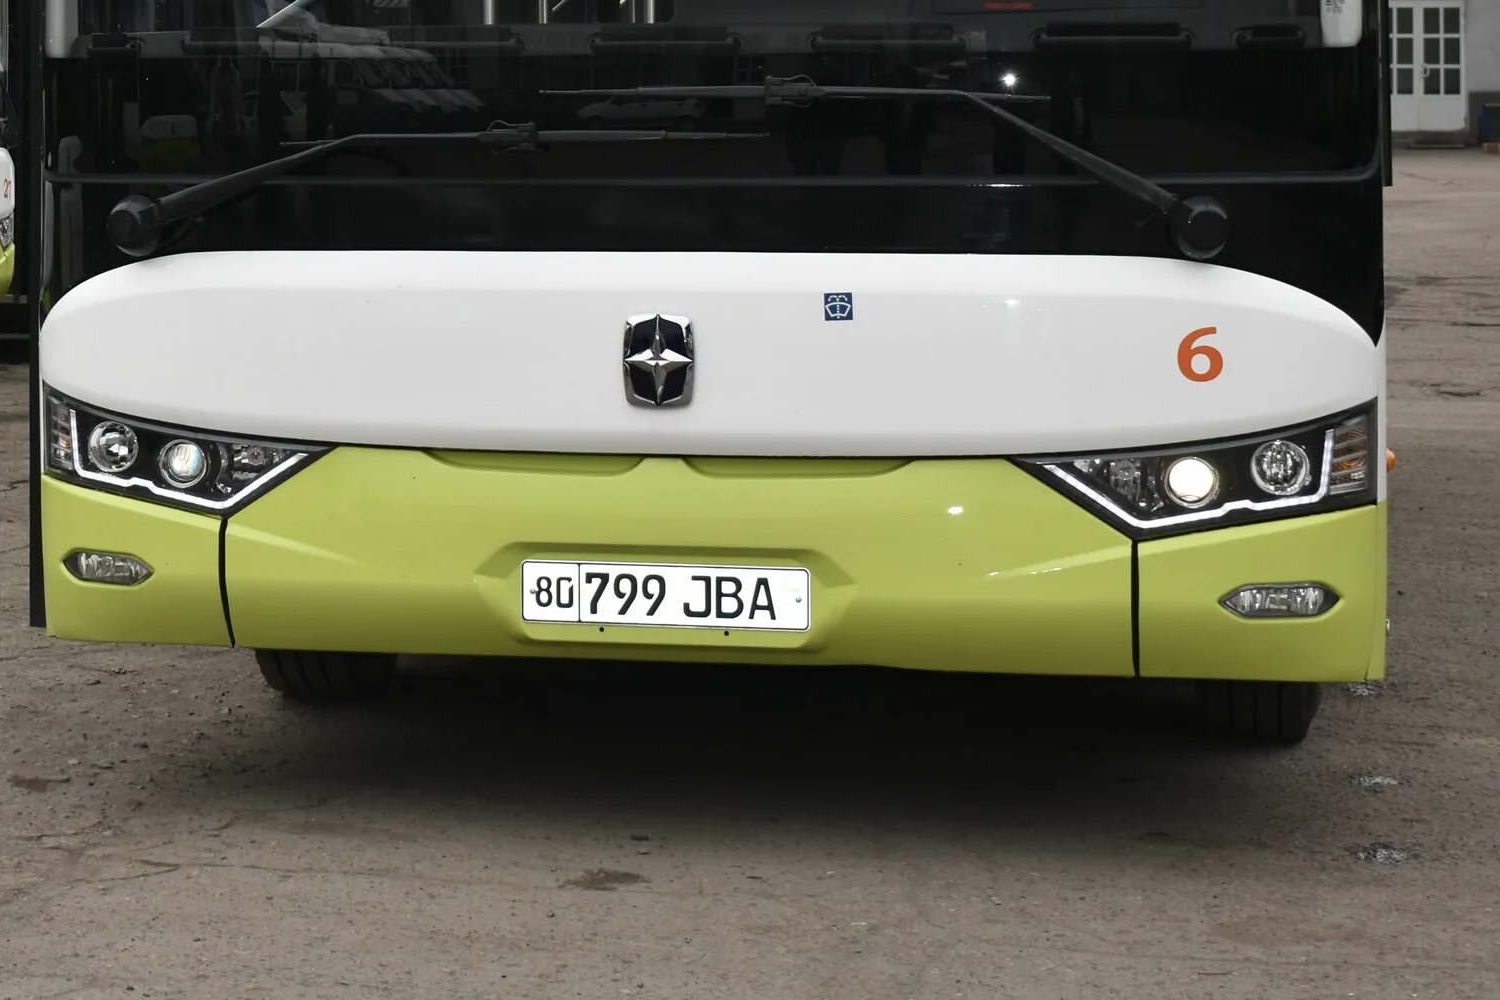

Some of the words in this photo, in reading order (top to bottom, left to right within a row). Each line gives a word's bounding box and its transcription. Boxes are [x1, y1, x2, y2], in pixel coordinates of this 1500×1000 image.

[1177, 326, 1223, 382] 6
[535, 576, 574, 609] 80
[585, 572, 666, 616] 799
[683, 575, 777, 620] JBA
